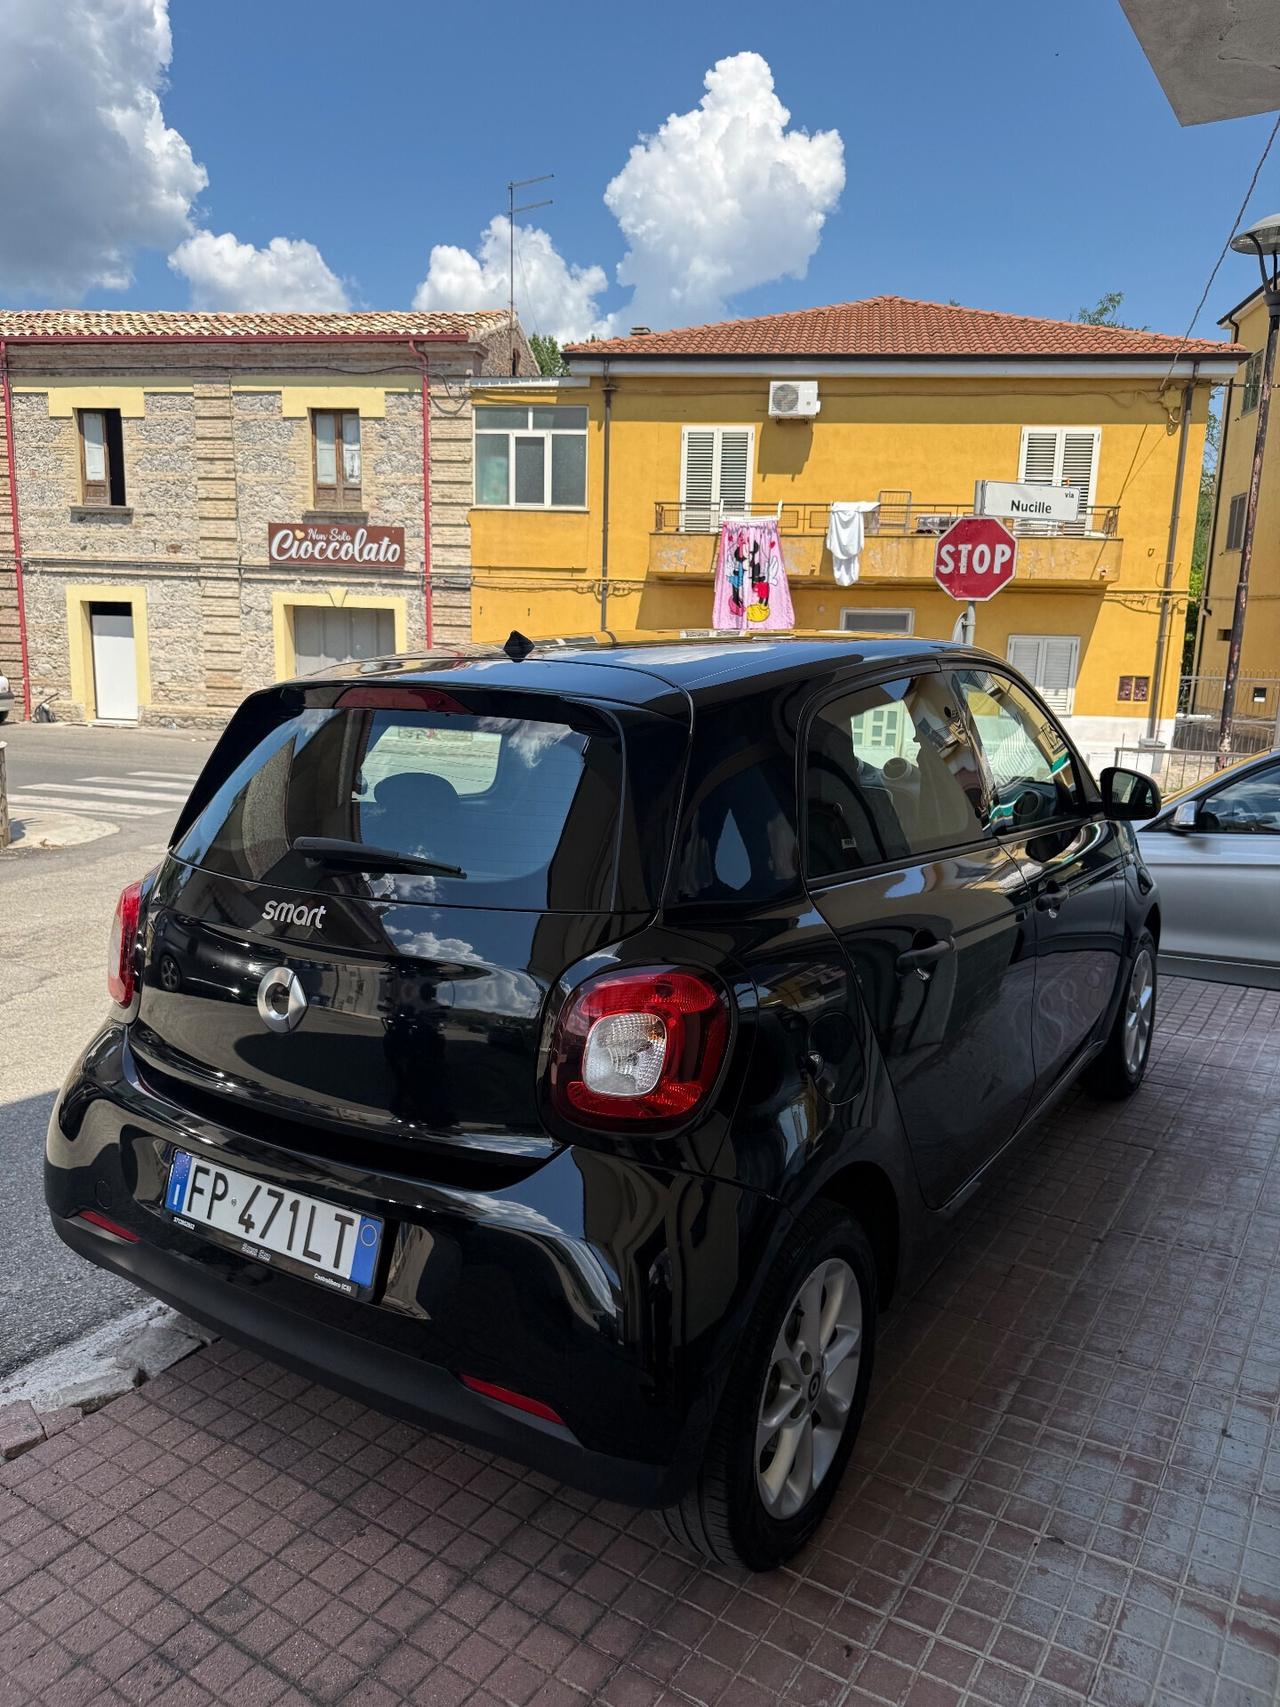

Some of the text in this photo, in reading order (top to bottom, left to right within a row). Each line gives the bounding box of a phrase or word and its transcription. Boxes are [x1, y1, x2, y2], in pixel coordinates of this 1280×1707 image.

[1064, 491, 1075, 499] via
[1010, 500, 1052, 514] Nucille
[307, 528, 352, 541] Non Solo
[271, 528, 401, 563] Cioccolato
[938, 543, 1012, 575] STOP
[261, 900, 327, 929] smart
